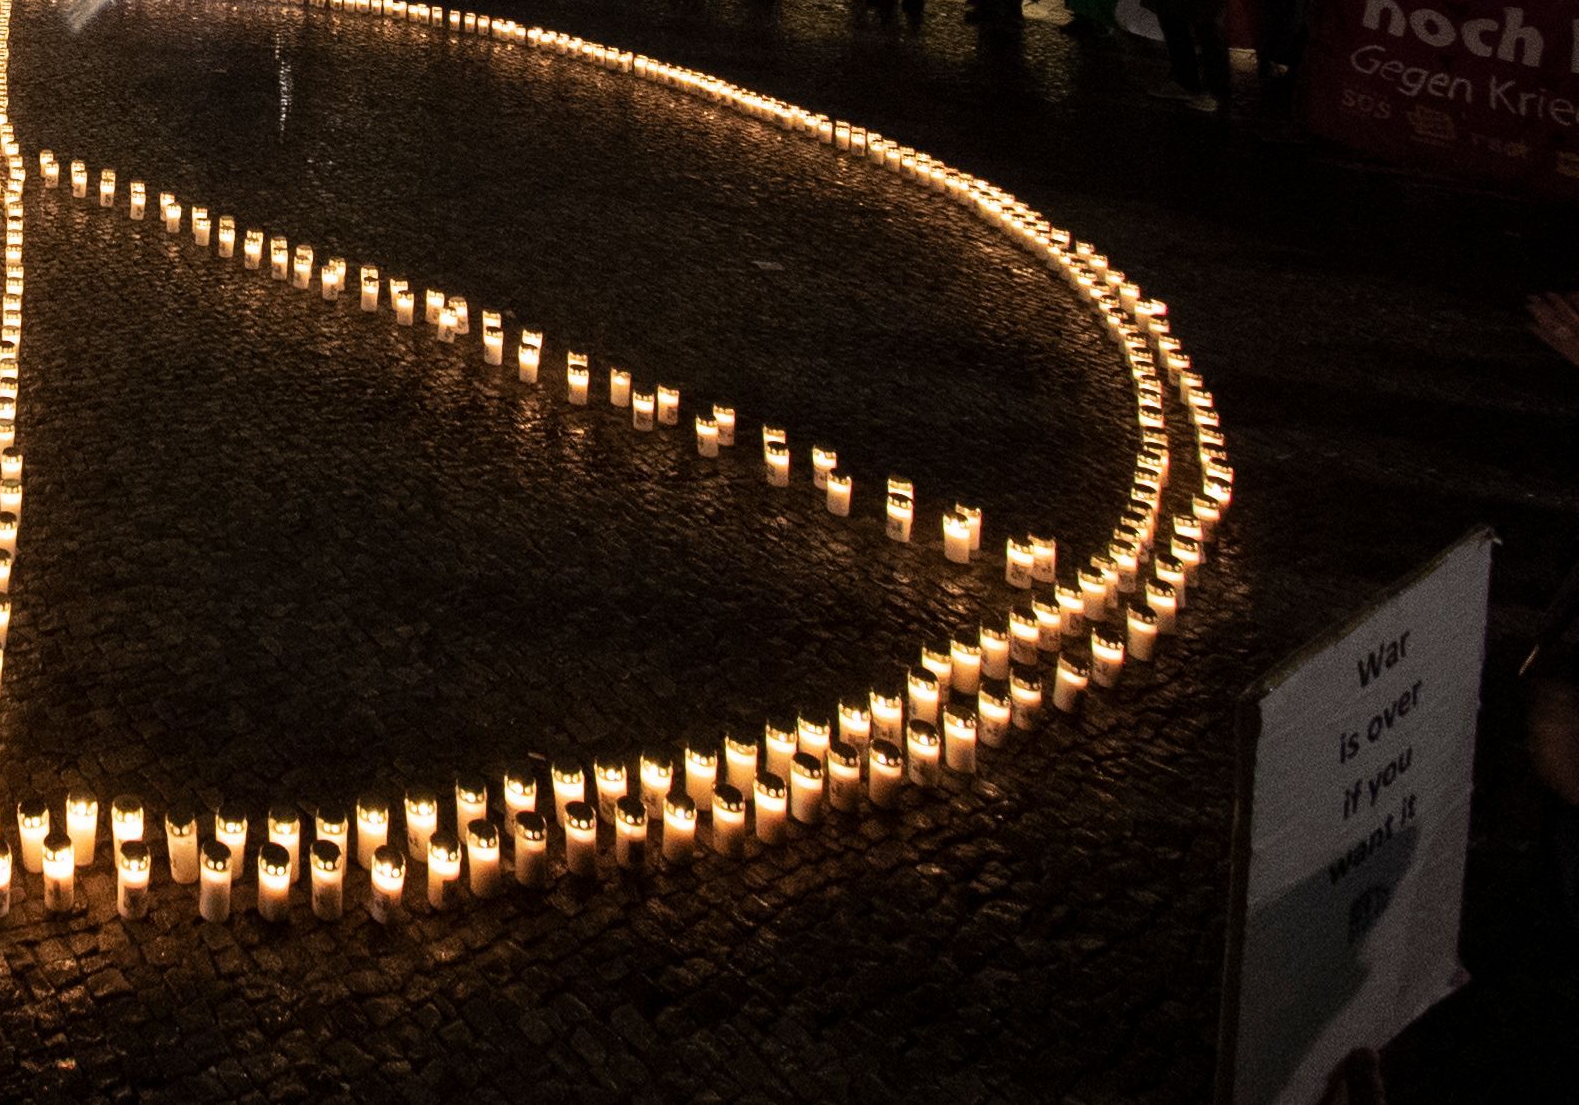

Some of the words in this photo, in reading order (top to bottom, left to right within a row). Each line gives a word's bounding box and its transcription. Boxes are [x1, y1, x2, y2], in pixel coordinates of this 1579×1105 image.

[1350, 44, 1473, 104] Gegen
[1489, 75, 1579, 127] Krie
[1357, 631, 1410, 688] War
[1340, 732, 1359, 764] is
[1368, 680, 1422, 743] over
[1344, 779, 1362, 820] if
[1369, 748, 1412, 808] you
[1329, 813, 1394, 885] want
[1401, 794, 1416, 827] it
